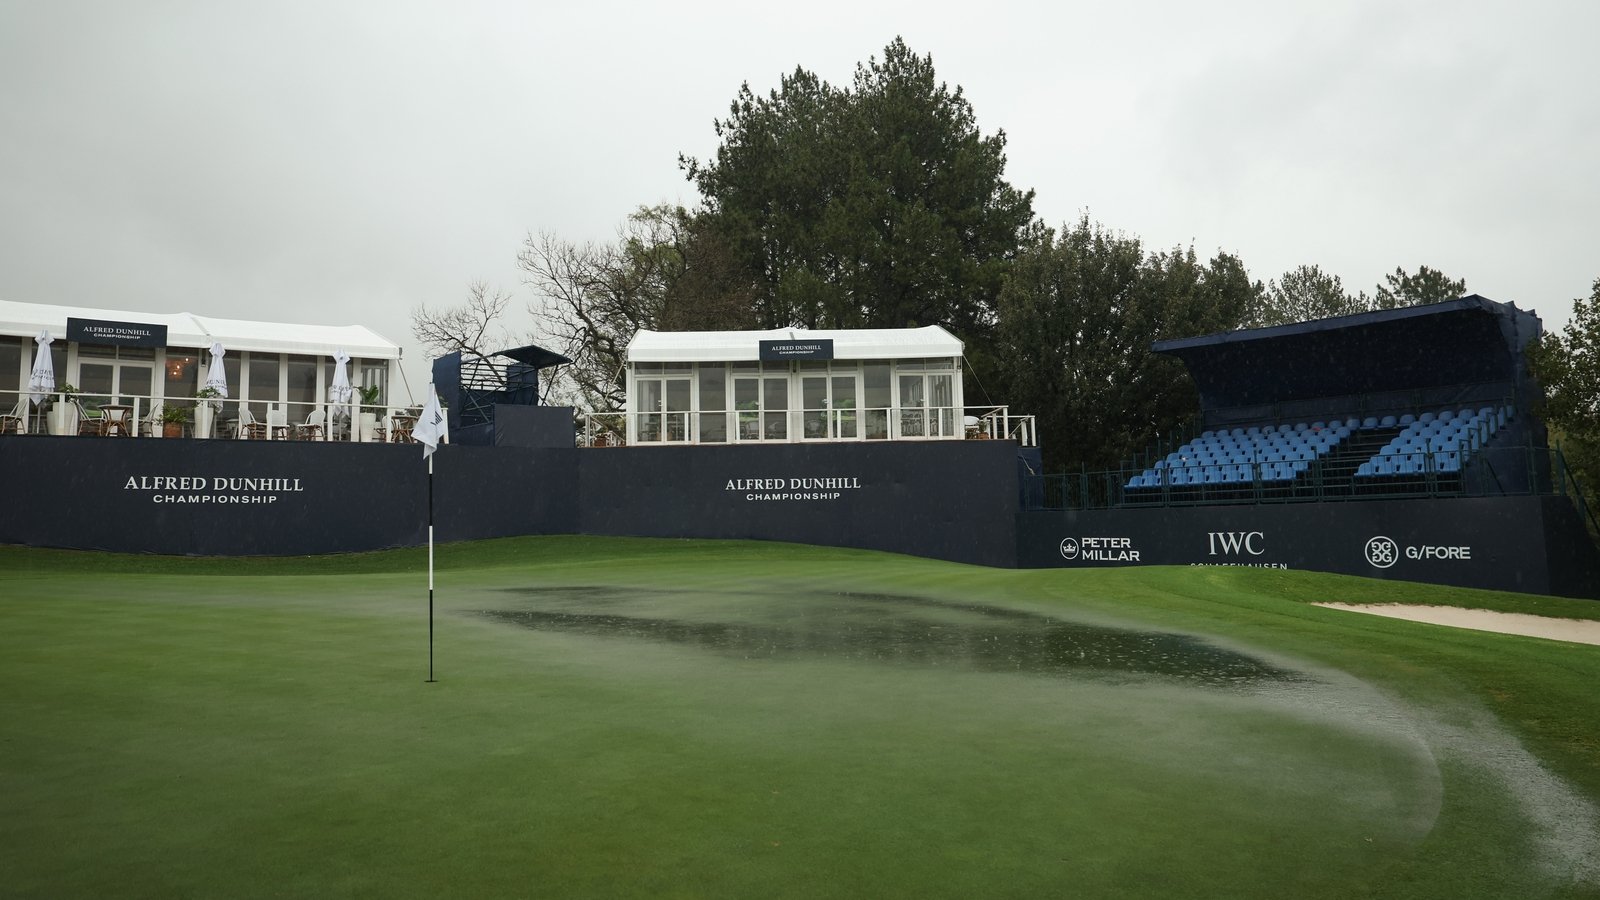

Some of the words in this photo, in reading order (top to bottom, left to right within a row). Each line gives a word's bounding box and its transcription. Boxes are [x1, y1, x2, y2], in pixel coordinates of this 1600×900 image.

[83, 326, 114, 334] ALFRED
[116, 328, 151, 336] DUNHILL
[124, 476, 207, 490] ALFRED
[213, 477, 304, 492] DUNHILL
[725, 478, 785, 491] ALFRED
[790, 477, 862, 490] DUNHILL
[153, 494, 278, 504] CHAMPIONSHIP
[746, 492, 841, 501] CHAMPIONSHIP
[1081, 537, 1131, 549] PETER
[1207, 531, 1265, 556] IWC
[1081, 549, 1140, 562] MILLAR
[1405, 545, 1472, 560] G/FORE
